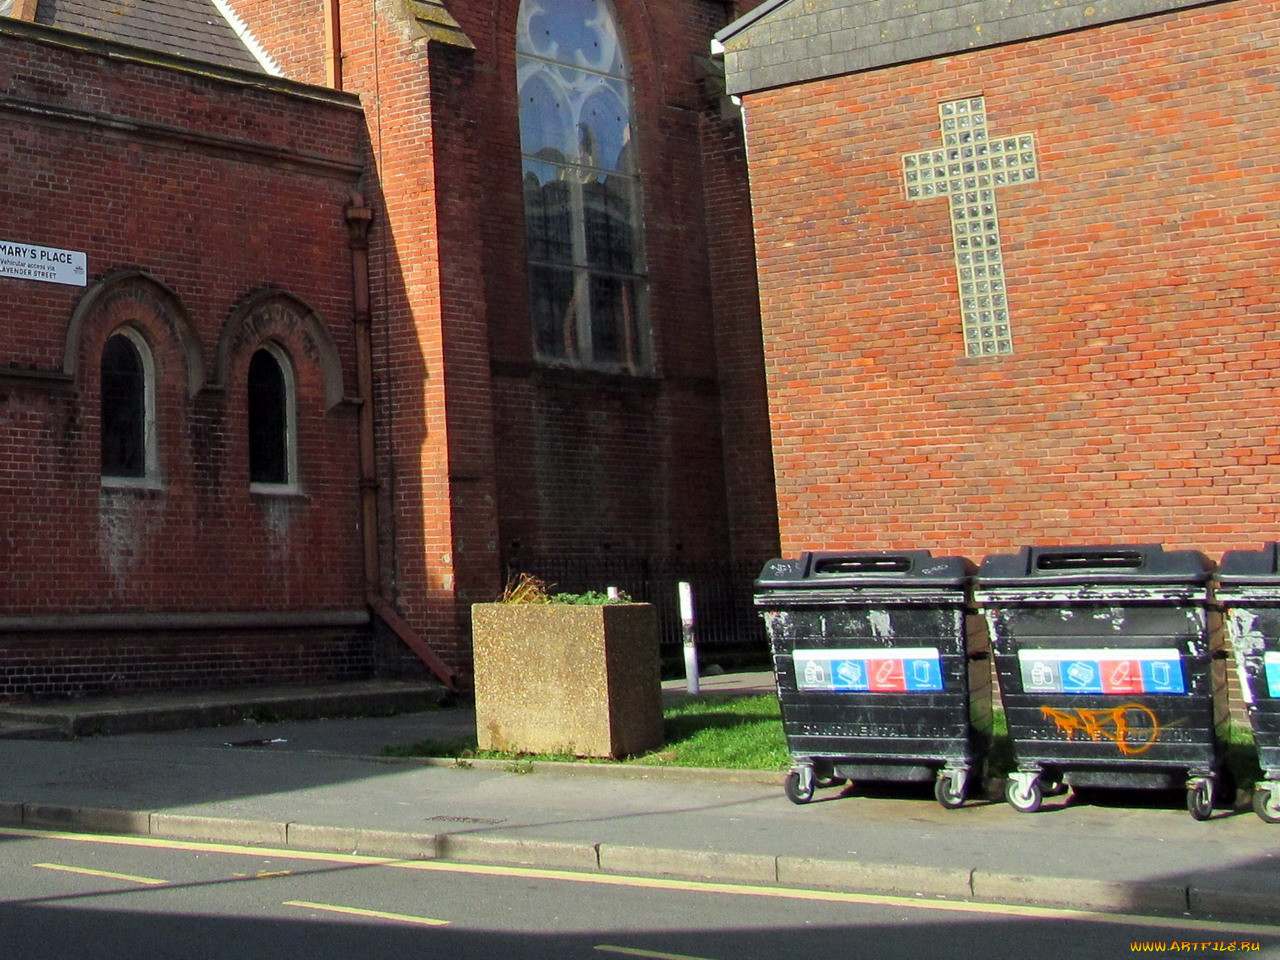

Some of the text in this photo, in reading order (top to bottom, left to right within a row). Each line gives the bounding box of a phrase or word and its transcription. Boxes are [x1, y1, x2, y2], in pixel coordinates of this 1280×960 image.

[40, 250, 73, 264] PLACE
[0, 258, 26, 267] Vehicular
[33, 270, 57, 279] STREET
